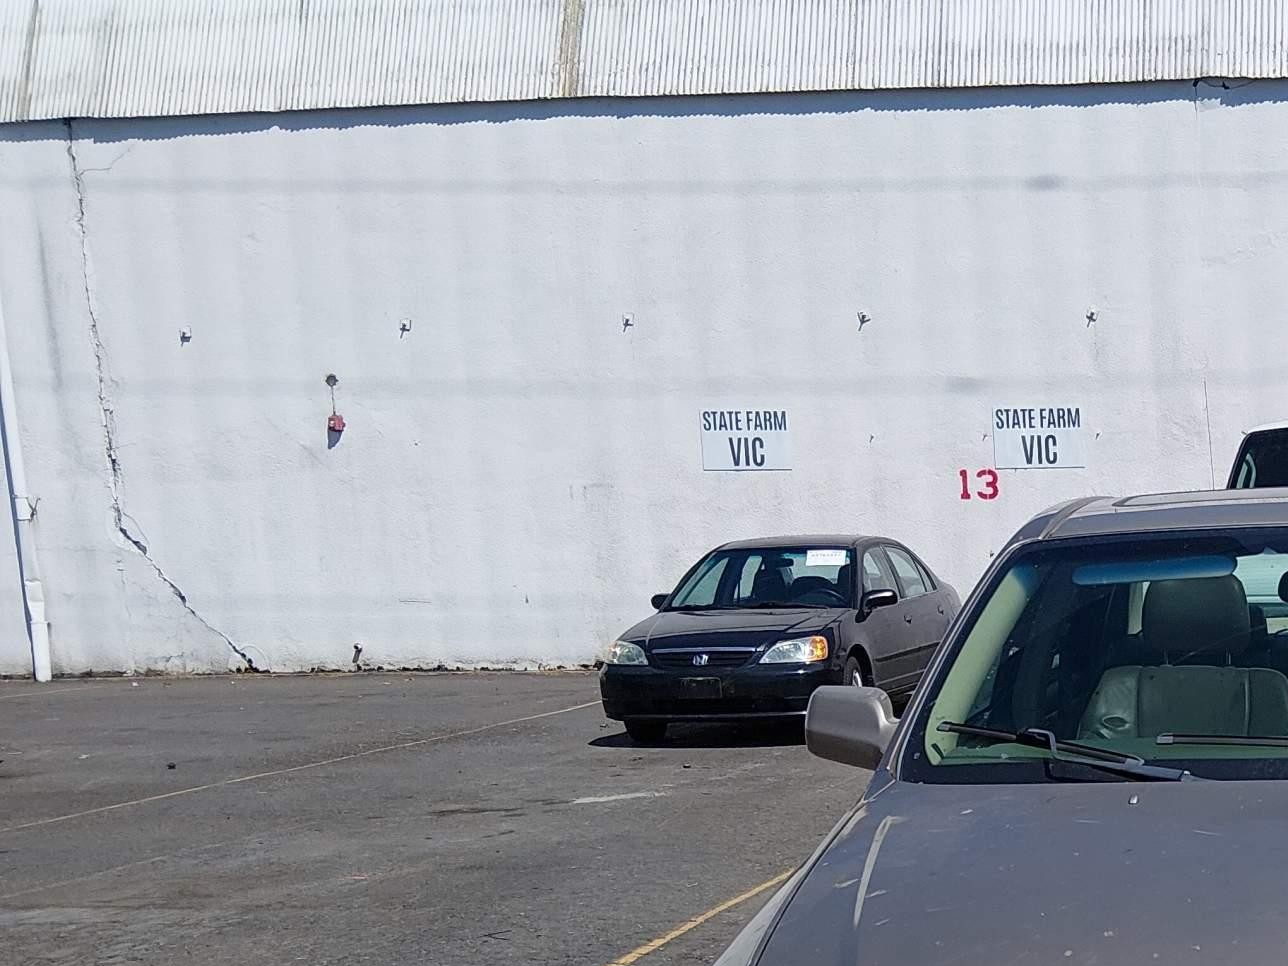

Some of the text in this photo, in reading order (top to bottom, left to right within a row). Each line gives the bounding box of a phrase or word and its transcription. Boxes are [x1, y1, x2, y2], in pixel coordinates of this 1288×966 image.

[702, 411, 787, 432] STATE FARM
[995, 408, 1081, 429] STATE FARM
[728, 436, 765, 467] VIC
[1021, 434, 1058, 465] VIC
[959, 468, 999, 501] 13
